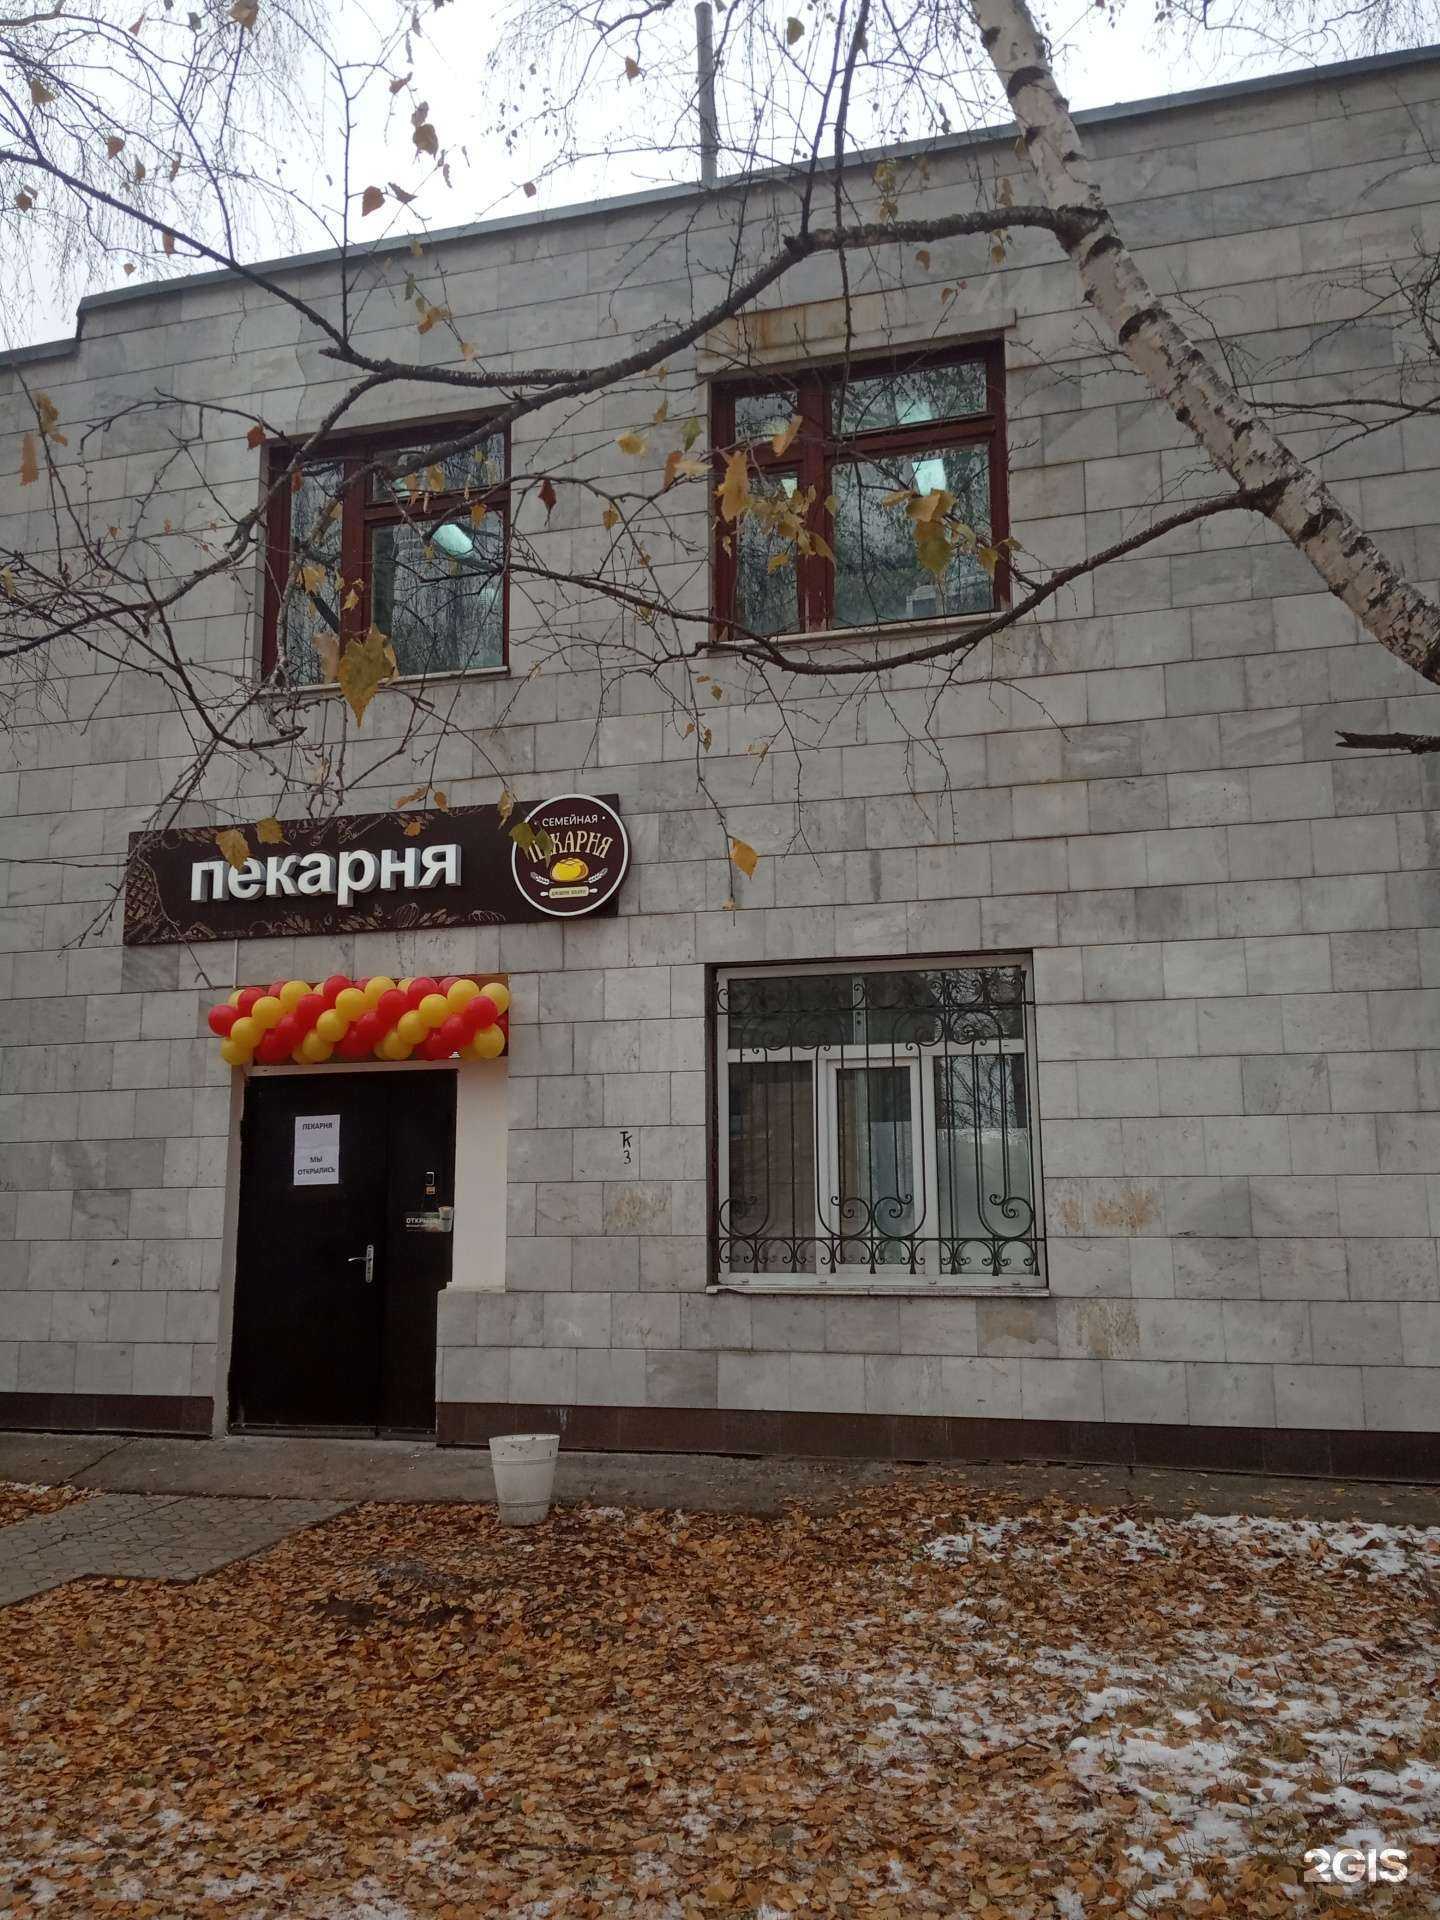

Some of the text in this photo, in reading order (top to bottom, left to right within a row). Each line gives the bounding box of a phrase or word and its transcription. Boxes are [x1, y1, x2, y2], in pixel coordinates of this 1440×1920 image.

[542, 813, 598, 827] СЕМЕЙНАЯ
[529, 830, 614, 864] ПКАРНЯ
[190, 843, 462, 907] пекарня
[302, 1122, 333, 1130] ПЕКАРНЯ
[309, 1155, 323, 1163] МЫ
[297, 1166, 336, 1176] ОТКРЫЛИСЬ
